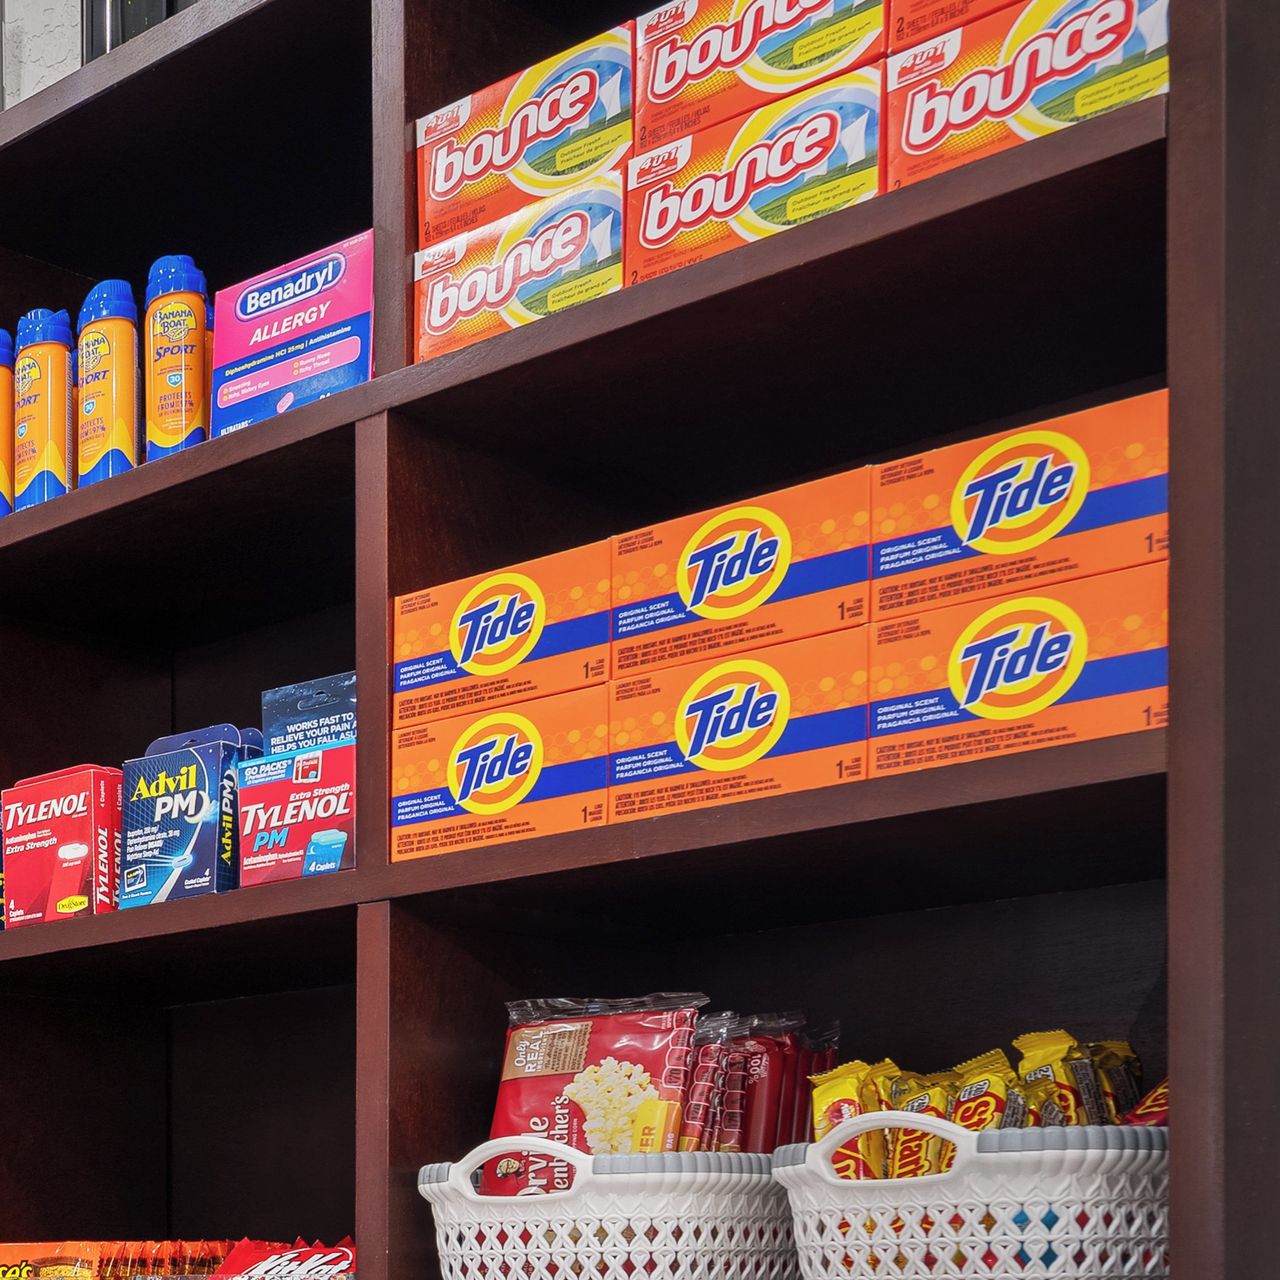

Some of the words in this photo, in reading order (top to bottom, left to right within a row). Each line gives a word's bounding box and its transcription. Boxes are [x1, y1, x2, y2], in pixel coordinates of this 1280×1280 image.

[896, 17, 904, 33] 2
[905, 0, 1131, 149] bounce
[433, 71, 594, 195] bounce
[643, 111, 834, 248] bounce
[428, 213, 587, 332] bounce
[246, 261, 334, 314] Benadryl
[154, 309, 193, 323] BANANA
[161, 321, 188, 333] BOAT
[249, 301, 332, 346] ALLERGY
[308, 325, 351, 346] Antihistamine
[154, 343, 197, 363] SPORT
[170, 376, 180, 385] 30
[961, 453, 1076, 546] Tide
[686, 528, 779, 611] Tide
[457, 592, 536, 667] Tide
[400, 661, 424, 673] ORIGINAL
[425, 657, 443, 668] SCENT
[400, 668, 421, 680] PARFUM
[422, 664, 447, 675] ORIGINAL
[959, 620, 1074, 709] Tide
[400, 674, 430, 686] FRAGANCIA
[431, 668, 456, 680] ORIGINAL
[287, 719, 318, 733] WORKS
[319, 715, 340, 728] FAST
[340, 712, 354, 723] TO
[684, 682, 778, 761] Tide
[271, 731, 305, 745] RELIEVE
[305, 727, 328, 739] YOUR
[329, 723, 350, 734] PAIN
[271, 742, 297, 755] HELPS
[298, 739, 316, 750] YOU
[317, 735, 338, 746] FALL
[245, 767, 258, 777] GO
[455, 733, 535, 805] Tide
[130, 765, 197, 801] Advil
[290, 792, 311, 803] Extra
[313, 782, 350, 799] Strength
[154, 791, 197, 822] PM
[223, 777, 234, 814] PM
[398, 797, 423, 808] ORIGINAL
[424, 793, 441, 804] SCENT
[5, 792, 88, 831] TYLENOL
[241, 794, 351, 836] TYLENOL
[398, 804, 419, 815] PARFUM
[420, 800, 446, 811] ORIGINAL
[398, 810, 428, 821] FRAGANCIA
[429, 805, 454, 816] ORIGINAL
[6, 843, 24, 855] Extra
[26, 837, 57, 851] Strength
[221, 814, 233, 866] Advil
[253, 827, 289, 852] PM
[97, 826, 109, 905] TYLENOL
[309, 862, 315, 872] 4
[316, 862, 336, 873] Caplets
[9, 900, 15, 910] 4
